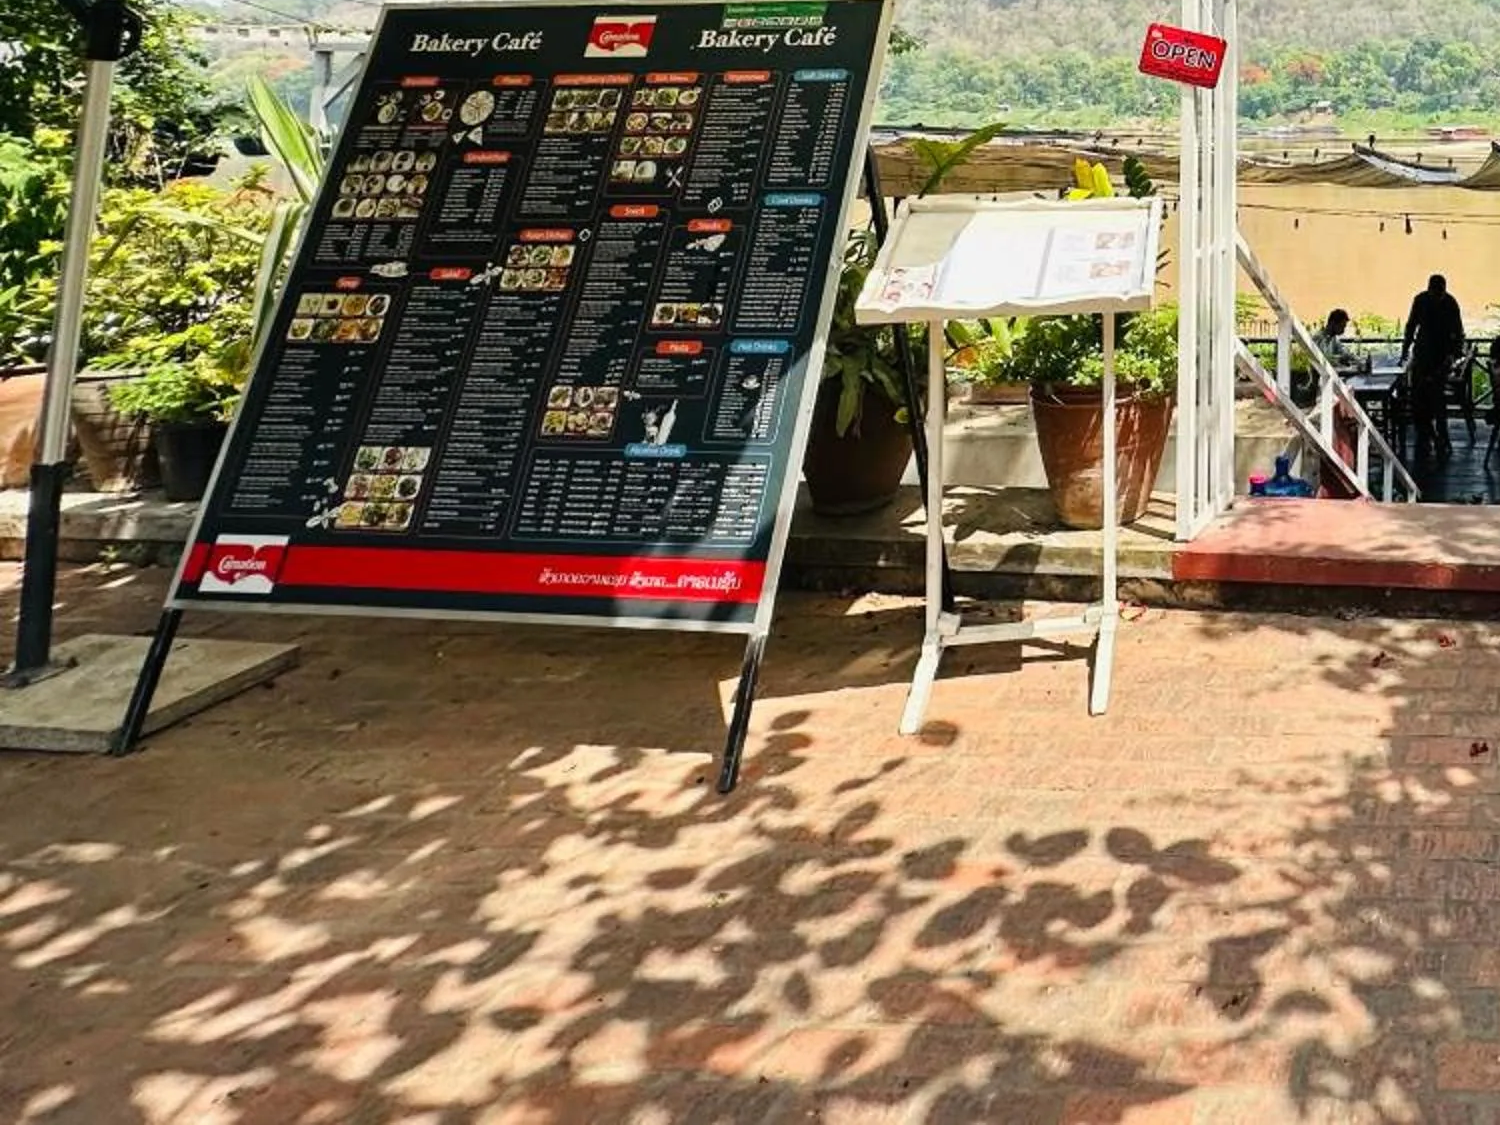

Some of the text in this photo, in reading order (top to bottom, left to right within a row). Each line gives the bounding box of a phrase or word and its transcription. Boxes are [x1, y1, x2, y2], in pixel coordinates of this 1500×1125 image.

[409, 31, 543, 57] Bakery Café
[697, 26, 837, 53] Bakery Café
[1151, 39, 1217, 71] OPEN
